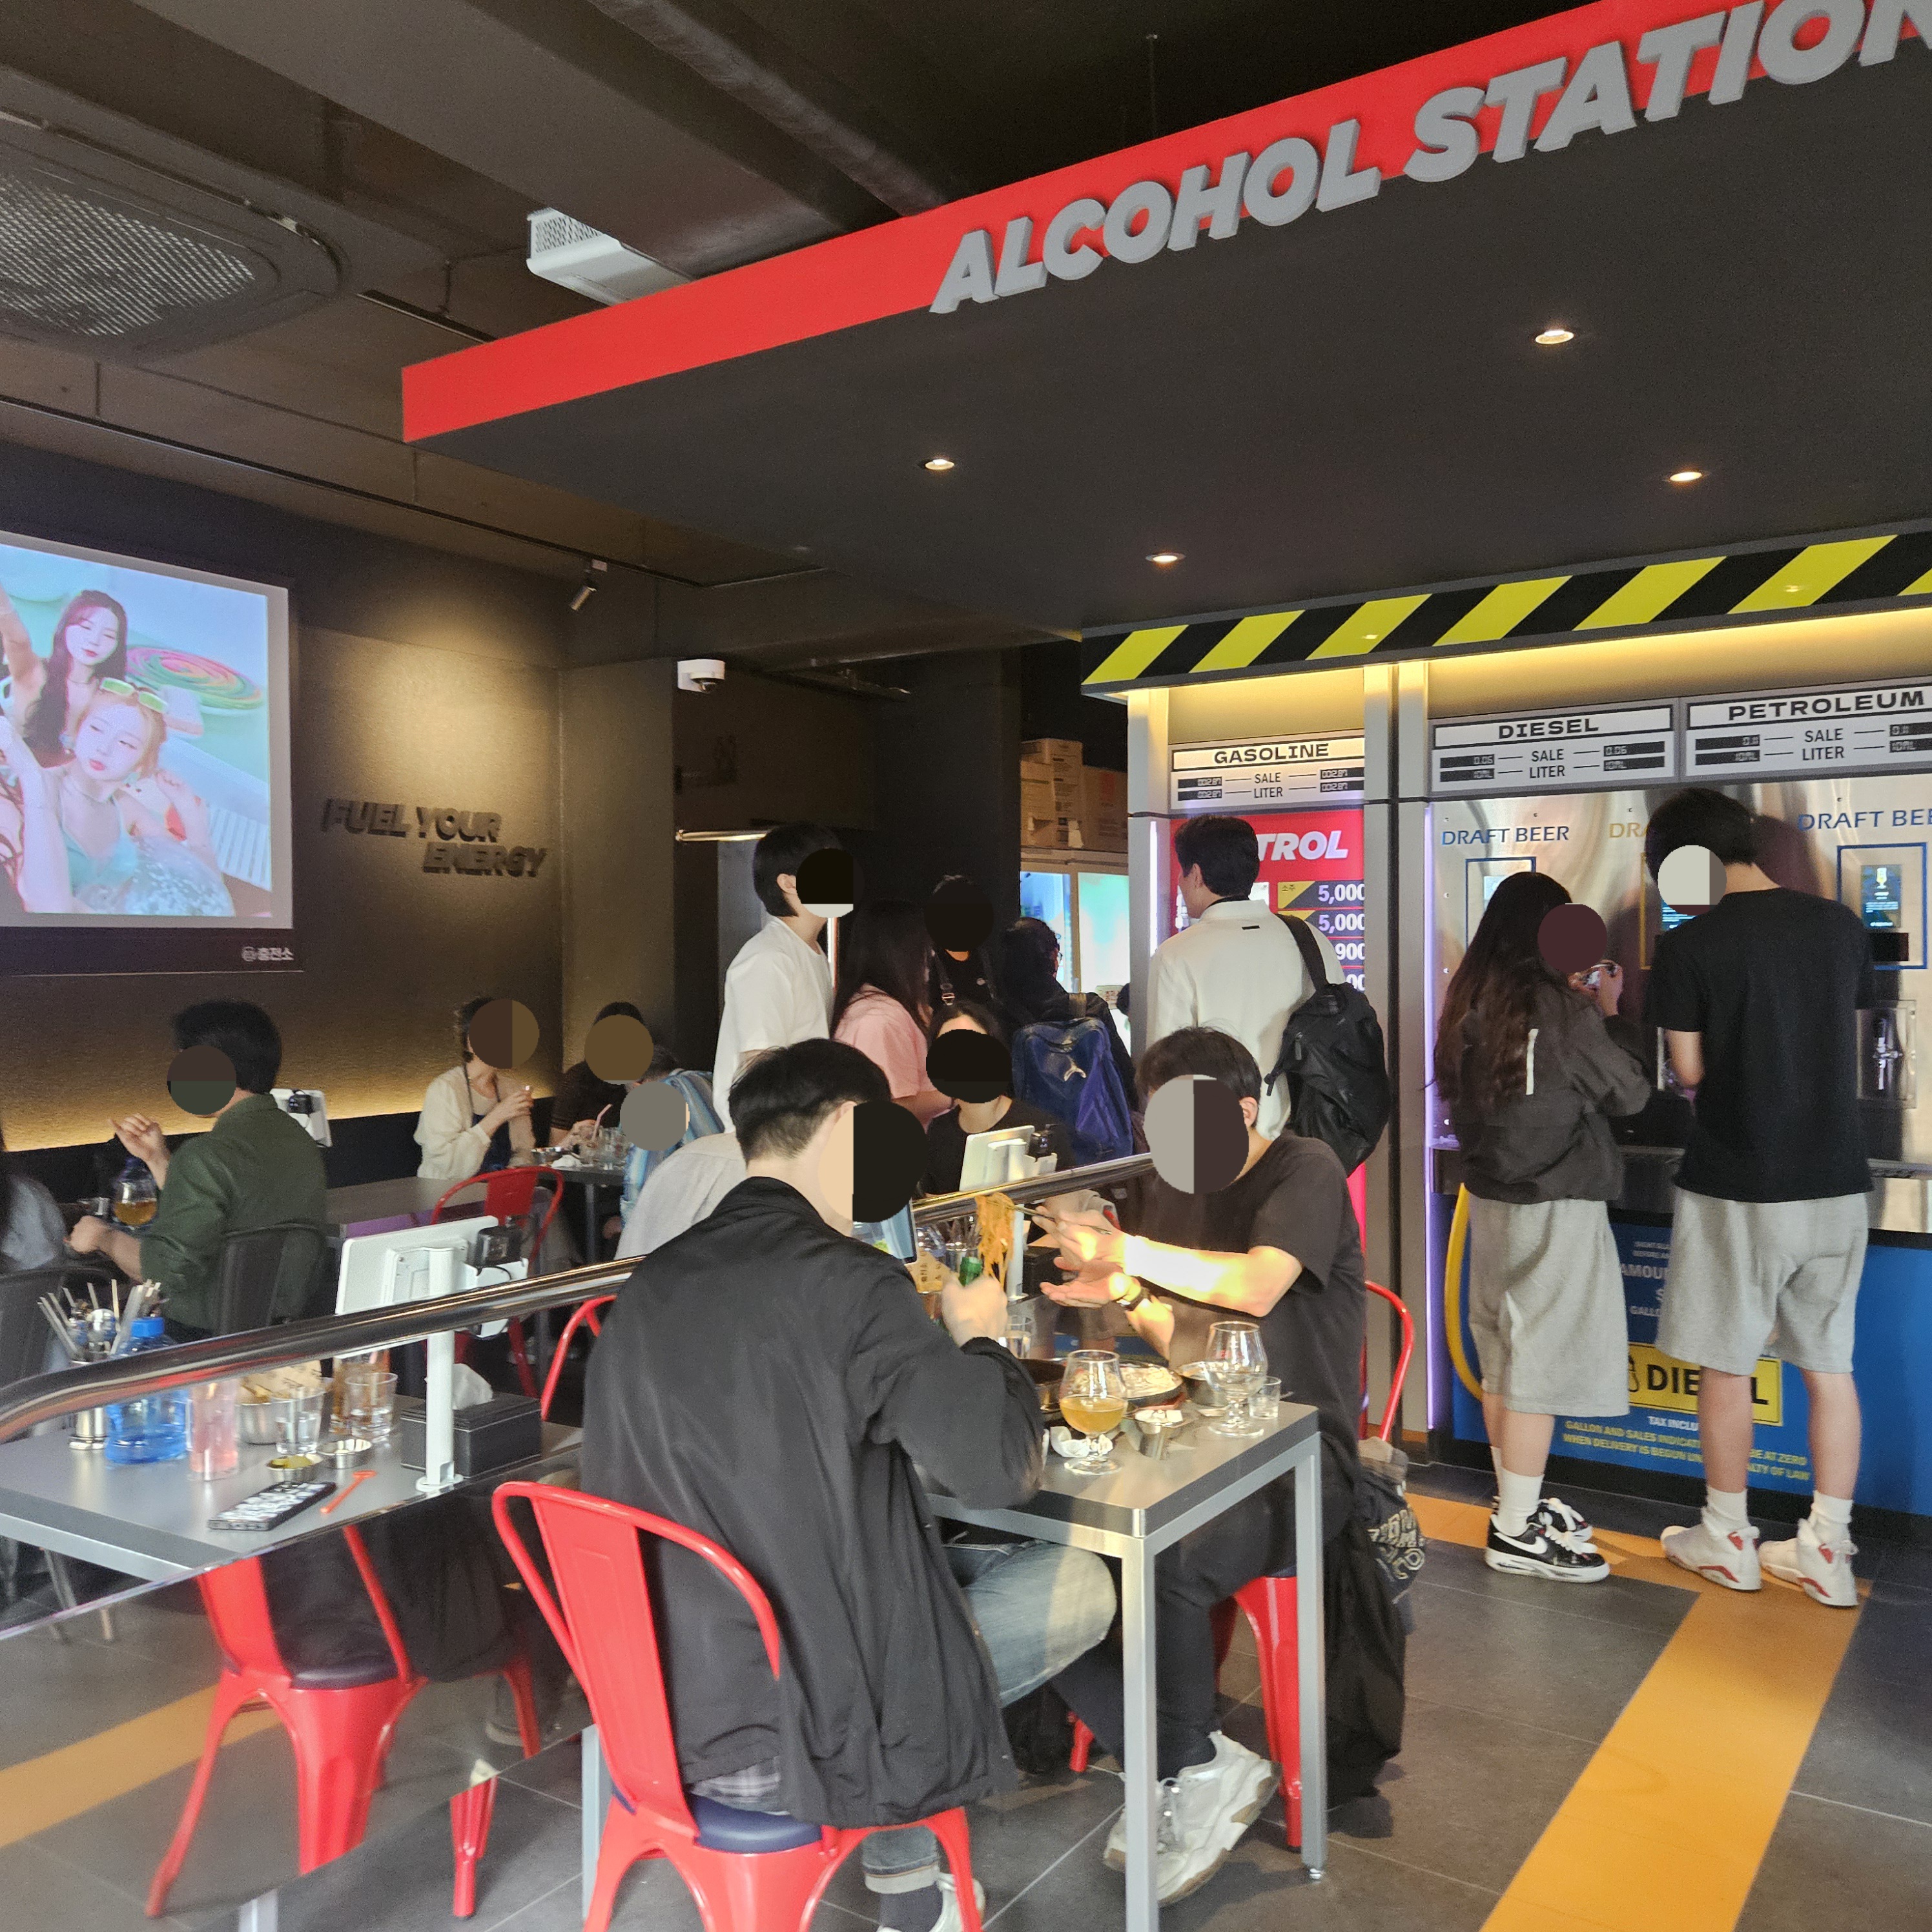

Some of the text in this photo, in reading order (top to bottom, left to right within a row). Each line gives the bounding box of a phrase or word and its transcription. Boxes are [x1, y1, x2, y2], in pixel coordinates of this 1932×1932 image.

[929, 119, 1381, 313] ALCOHOL
[1728, 691, 1924, 721] PETROLEUM
[1499, 718, 1599, 739] DIESEL
[1805, 728, 1844, 743] SALE
[1214, 743, 1329, 764] GASOLINE
[1532, 749, 1565, 762] SALE
[1802, 746, 1844, 761] LITER
[1254, 772, 1281, 784] SALE
[1530, 765, 1565, 779] LITER
[1254, 787, 1283, 798] LITER
[322, 797, 502, 843] FUEL YOUR
[1797, 808, 1932, 831] DRAFT BE
[1255, 830, 1349, 861] TROL
[1441, 826, 1570, 845] DRAFT BEER
[422, 841, 548, 878] ENERGY
[1336, 943, 1365, 960] 900
